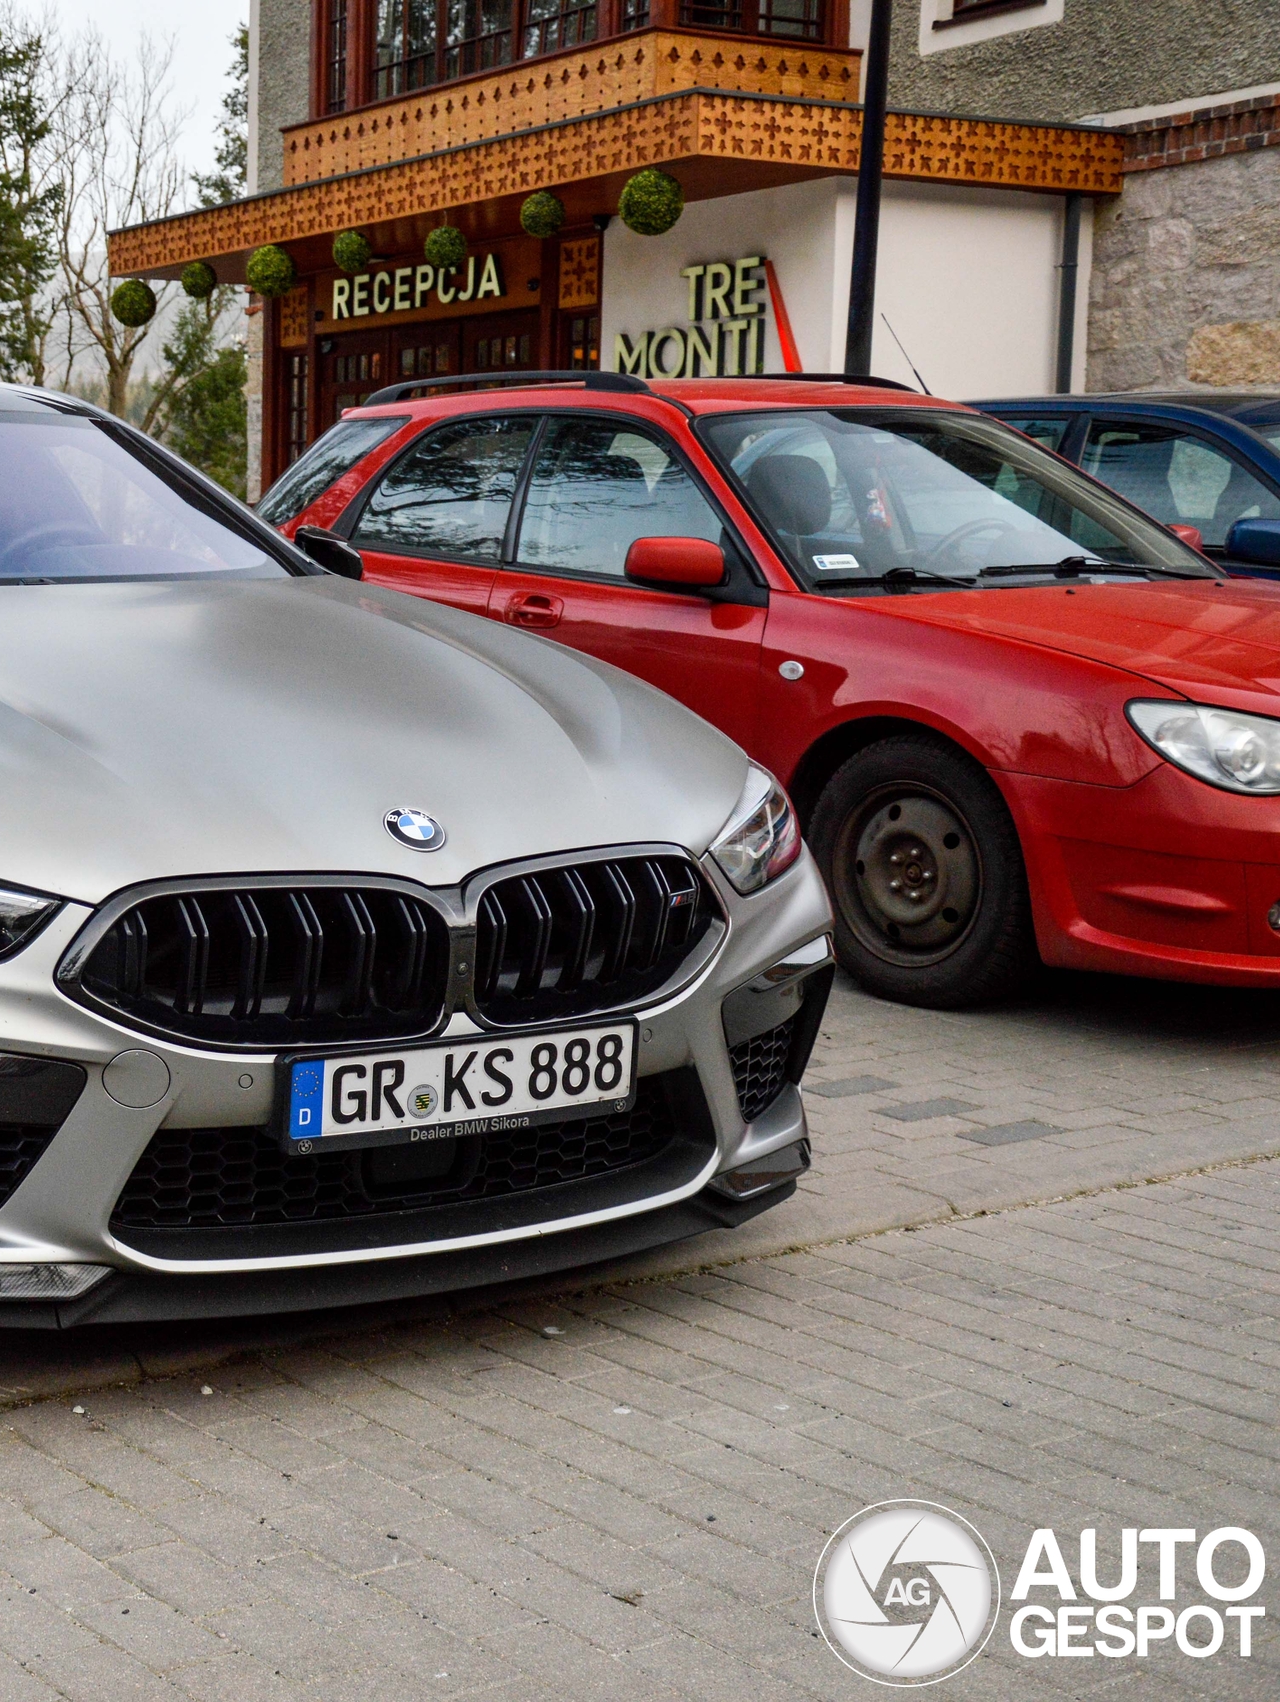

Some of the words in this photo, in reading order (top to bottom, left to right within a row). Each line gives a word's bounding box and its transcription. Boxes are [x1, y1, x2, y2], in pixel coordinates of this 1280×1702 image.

[332, 253, 501, 320] RECEPCJA
[681, 256, 766, 321] TRE
[615, 318, 766, 378] MONTI
[331, 1059, 405, 1125] GR
[443, 1047, 514, 1113] KS
[528, 1033, 624, 1100] 888
[298, 1108, 312, 1126] D
[410, 1122, 453, 1142] Dealer
[454, 1119, 488, 1138] BMW
[490, 1115, 530, 1133] Sikora
